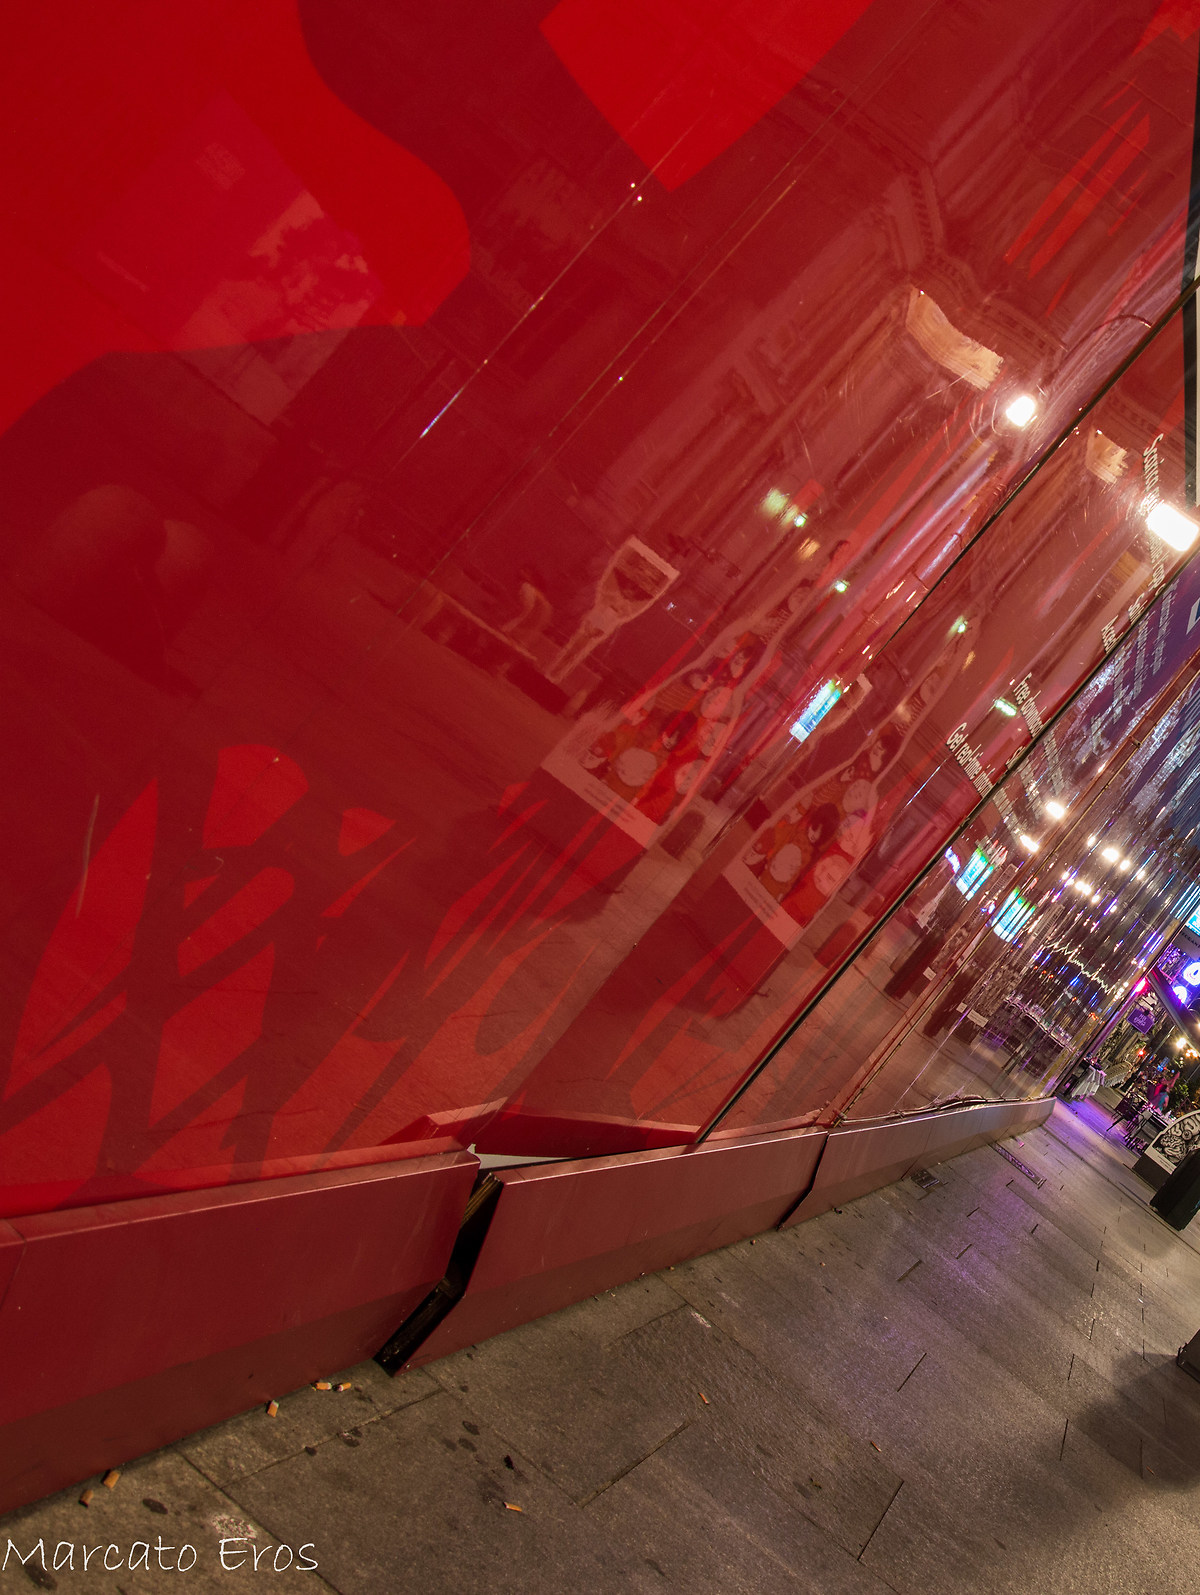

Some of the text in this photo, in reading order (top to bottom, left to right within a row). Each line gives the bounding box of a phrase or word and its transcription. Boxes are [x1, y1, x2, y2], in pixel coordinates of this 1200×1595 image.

[1143, 433, 1165, 493] Scarica
[1013, 672, 1051, 738] Free download
[946, 722, 968, 753] Get
[955, 743, 984, 780] real-time
